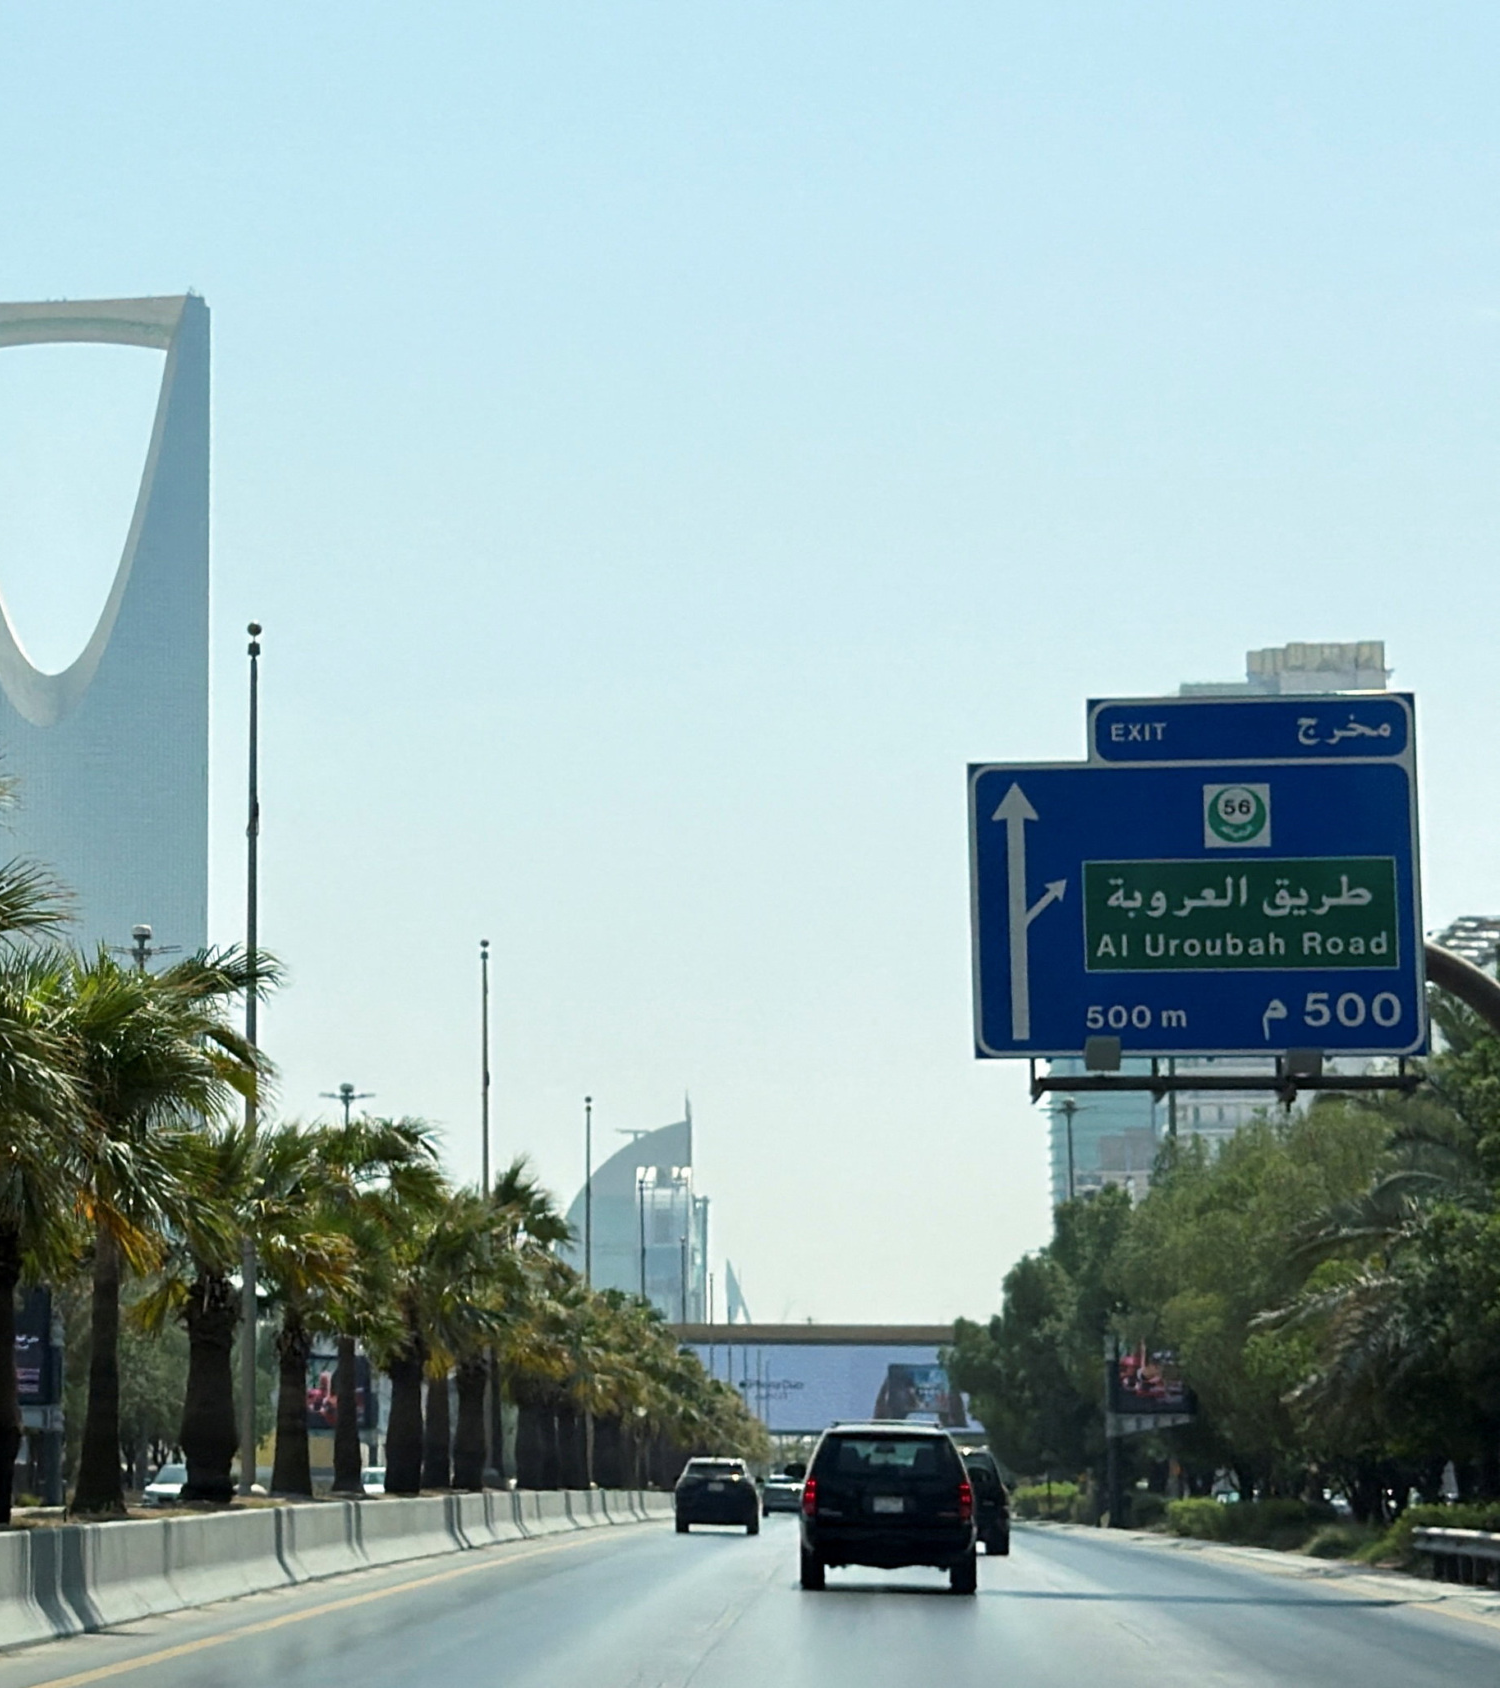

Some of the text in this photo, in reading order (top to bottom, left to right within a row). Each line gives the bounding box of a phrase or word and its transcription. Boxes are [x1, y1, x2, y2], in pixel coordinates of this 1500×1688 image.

[1110, 722, 1167, 742] EXIT
[1297, 713, 1392, 746] مخرج
[1224, 799, 1251, 816] 56
[1106, 874, 1373, 918] طريق العروبة
[1096, 931, 1388, 957] Al Uroubah Road
[1085, 1005, 1187, 1029] 500 m
[1262, 992, 1402, 1041] 500 م
